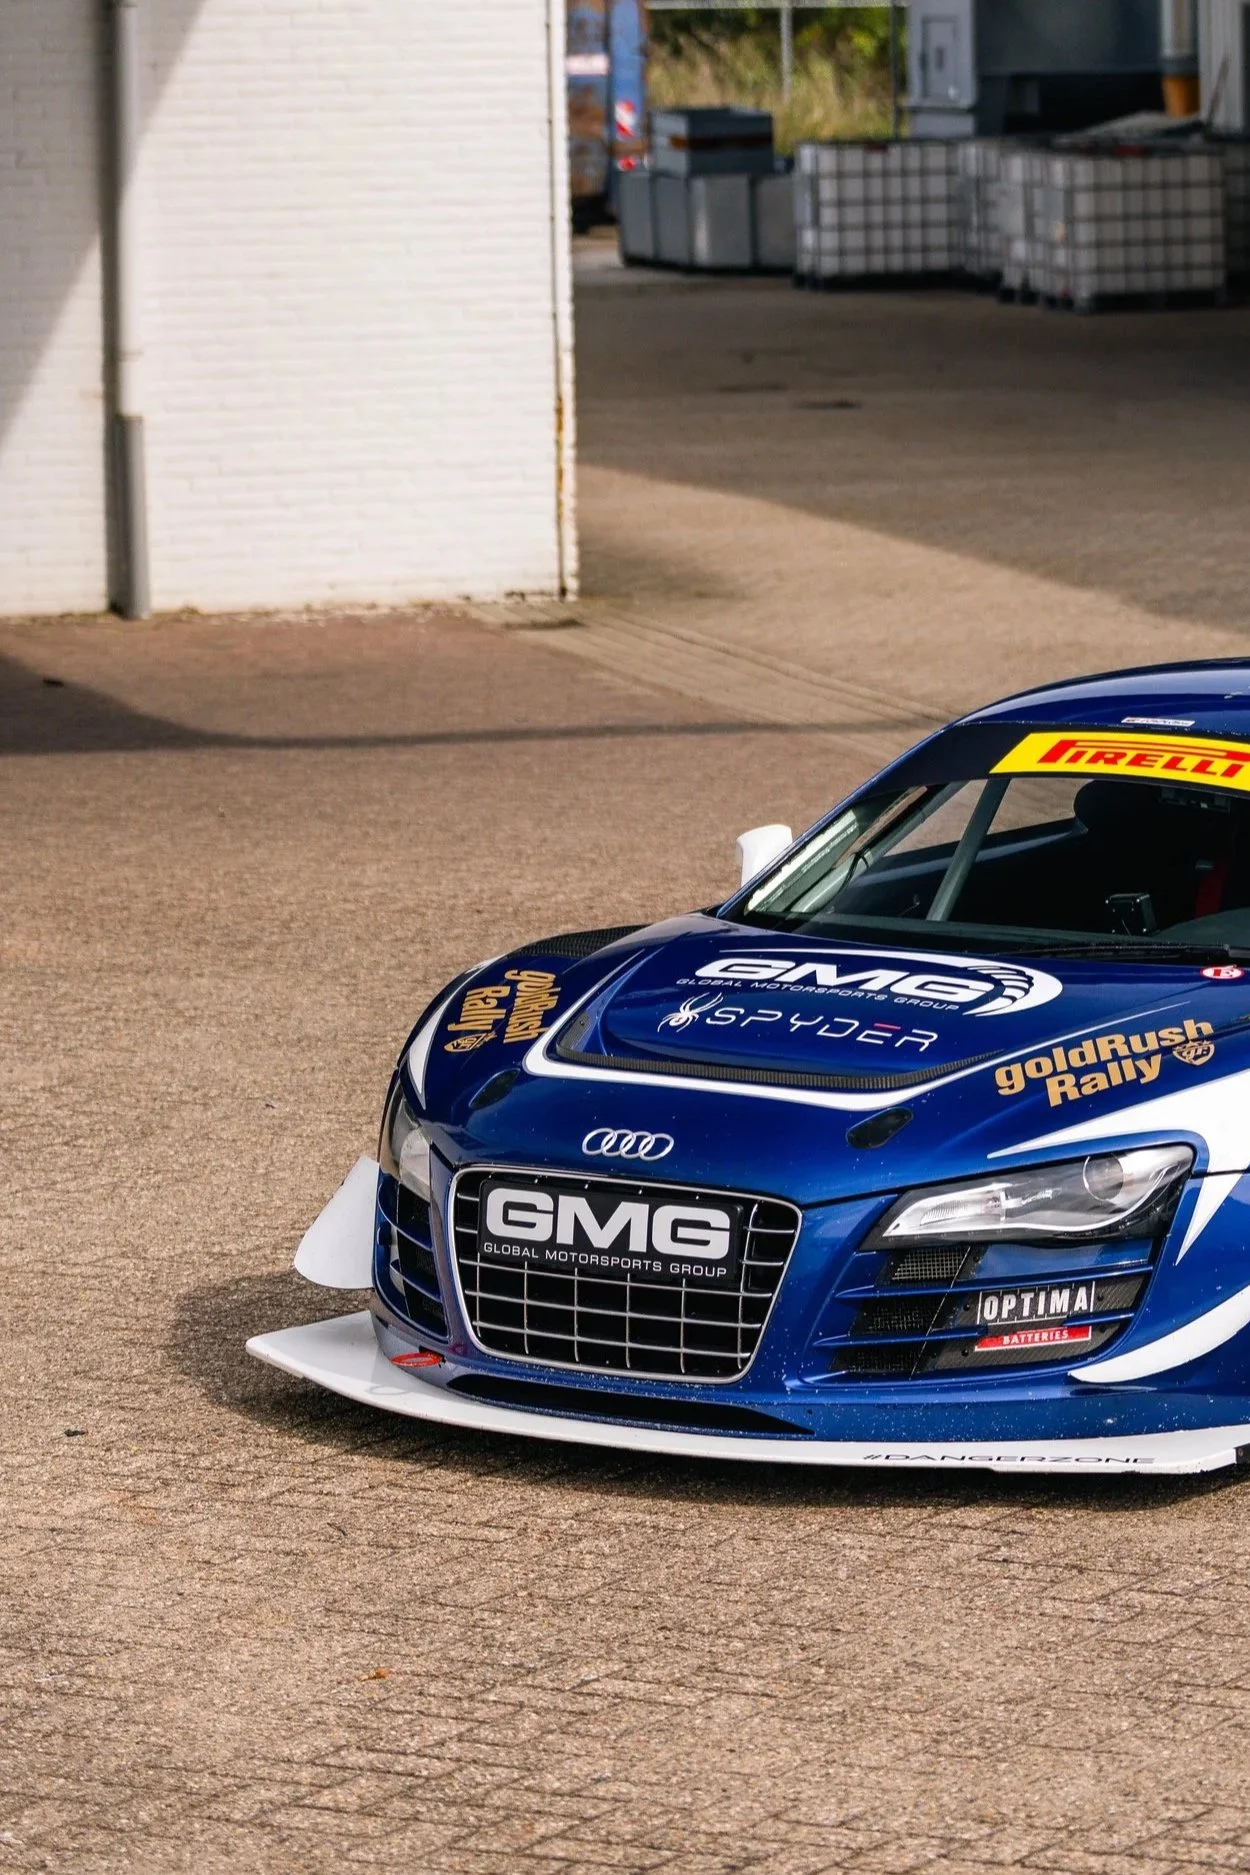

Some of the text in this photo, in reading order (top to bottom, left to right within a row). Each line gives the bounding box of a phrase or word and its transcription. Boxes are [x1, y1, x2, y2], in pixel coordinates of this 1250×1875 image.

[676, 977, 960, 1012] GLOBAL MOTORSPORTS GROUP
[694, 957, 994, 1003] GMG
[447, 986, 511, 1031] Rally
[503, 969, 561, 1044] goldRush
[706, 1006, 938, 1053] SPYDER
[995, 1019, 1215, 1096] goldRush
[1045, 1054, 1162, 1108] Rally
[486, 1187, 730, 1260] GMG
[483, 1242, 727, 1277] GLOBAL MOTORSPORTS GROUP
[983, 1286, 1088, 1320] OPTIMA
[1003, 1330, 1069, 1344] BATTERIES
[863, 1454, 1154, 1464] #DANGERZONE
